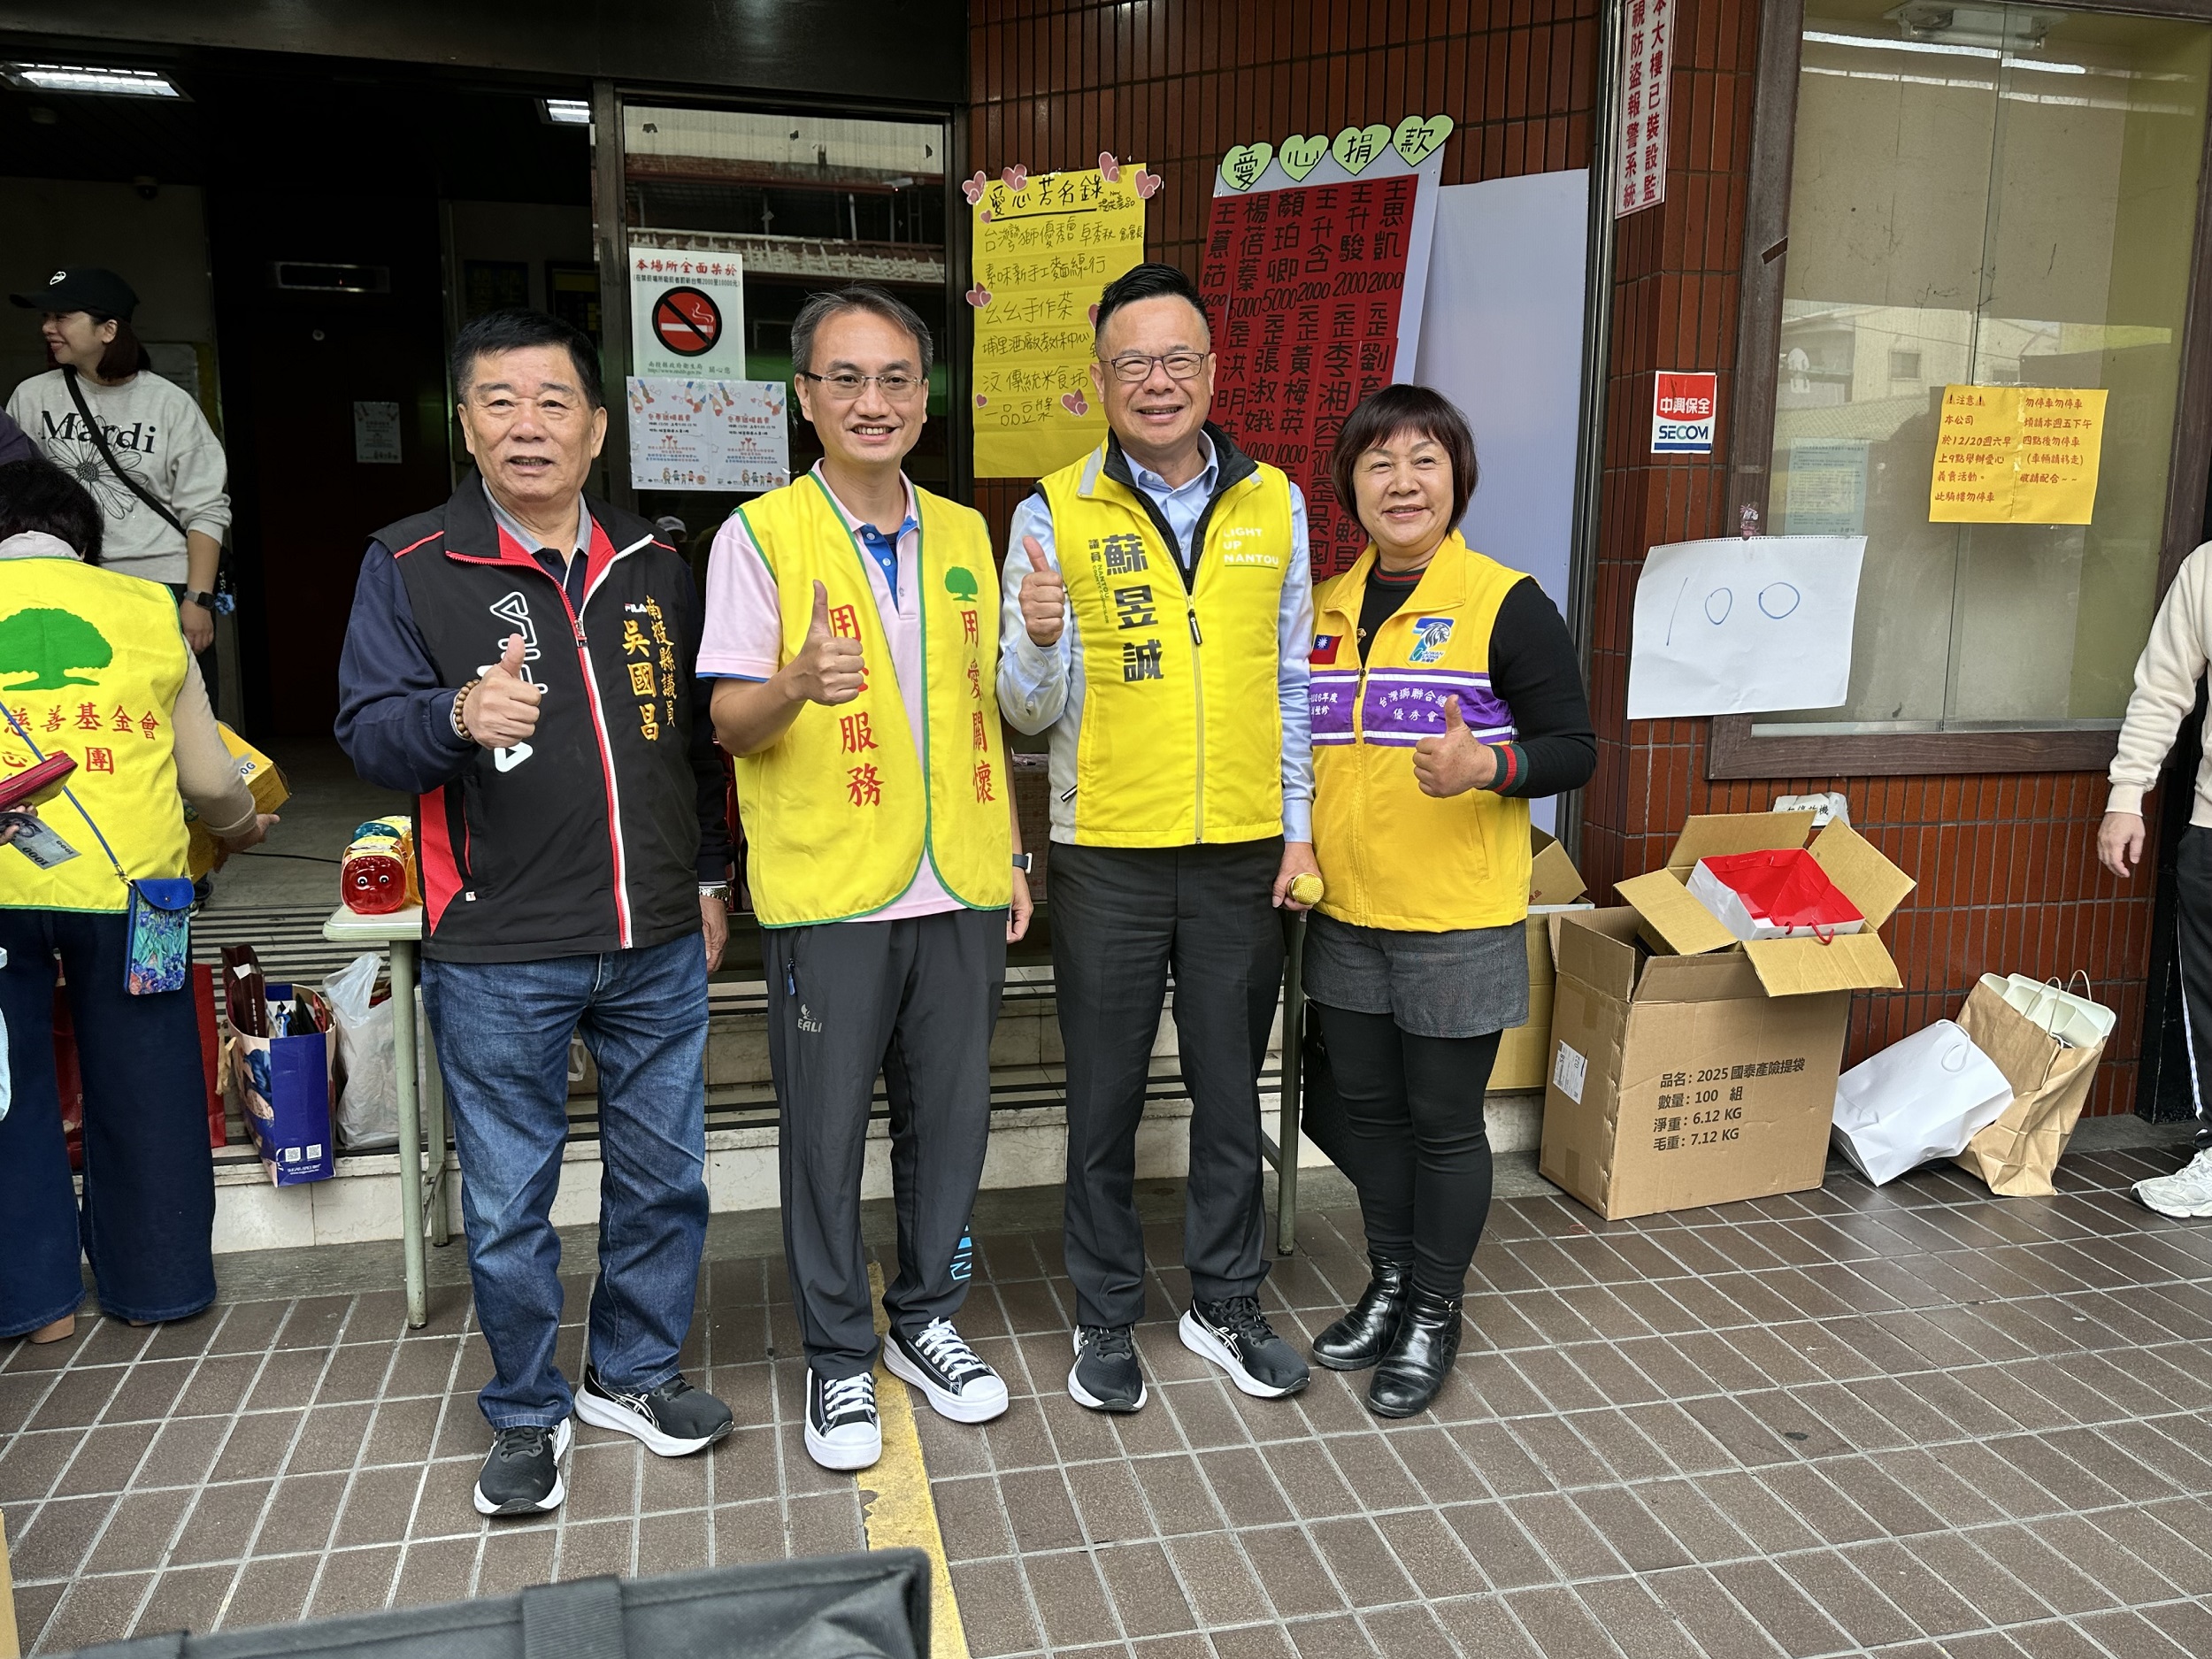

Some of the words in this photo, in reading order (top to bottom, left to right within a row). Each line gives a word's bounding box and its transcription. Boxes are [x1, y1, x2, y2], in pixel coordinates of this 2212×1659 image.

[1660, 396, 1711, 415] 中興保全
[1945, 414, 1974, 426] 本公司
[41, 411, 156, 454] Mardi
[1659, 425, 1709, 440] SECOM
[1224, 541, 1241, 550] UP
[1224, 554, 1279, 565] NANTOU
[1102, 533, 1165, 683] 蘇昱誠
[622, 619, 660, 741] 吳國昌
[829, 603, 885, 807] 用服務
[960, 609, 995, 805] 用愛關懷
[4, 702, 160, 741] 慈善基金會
[2, 746, 115, 775] 心團
[1694, 1089, 1718, 1103] 100
[1729, 1087, 1743, 1102] 組
[1693, 1110, 1719, 1125] 6.12
[1724, 1108, 1742, 1120] KG
[1691, 1131, 1717, 1146] 7.12
[1722, 1128, 1740, 1141] KG
